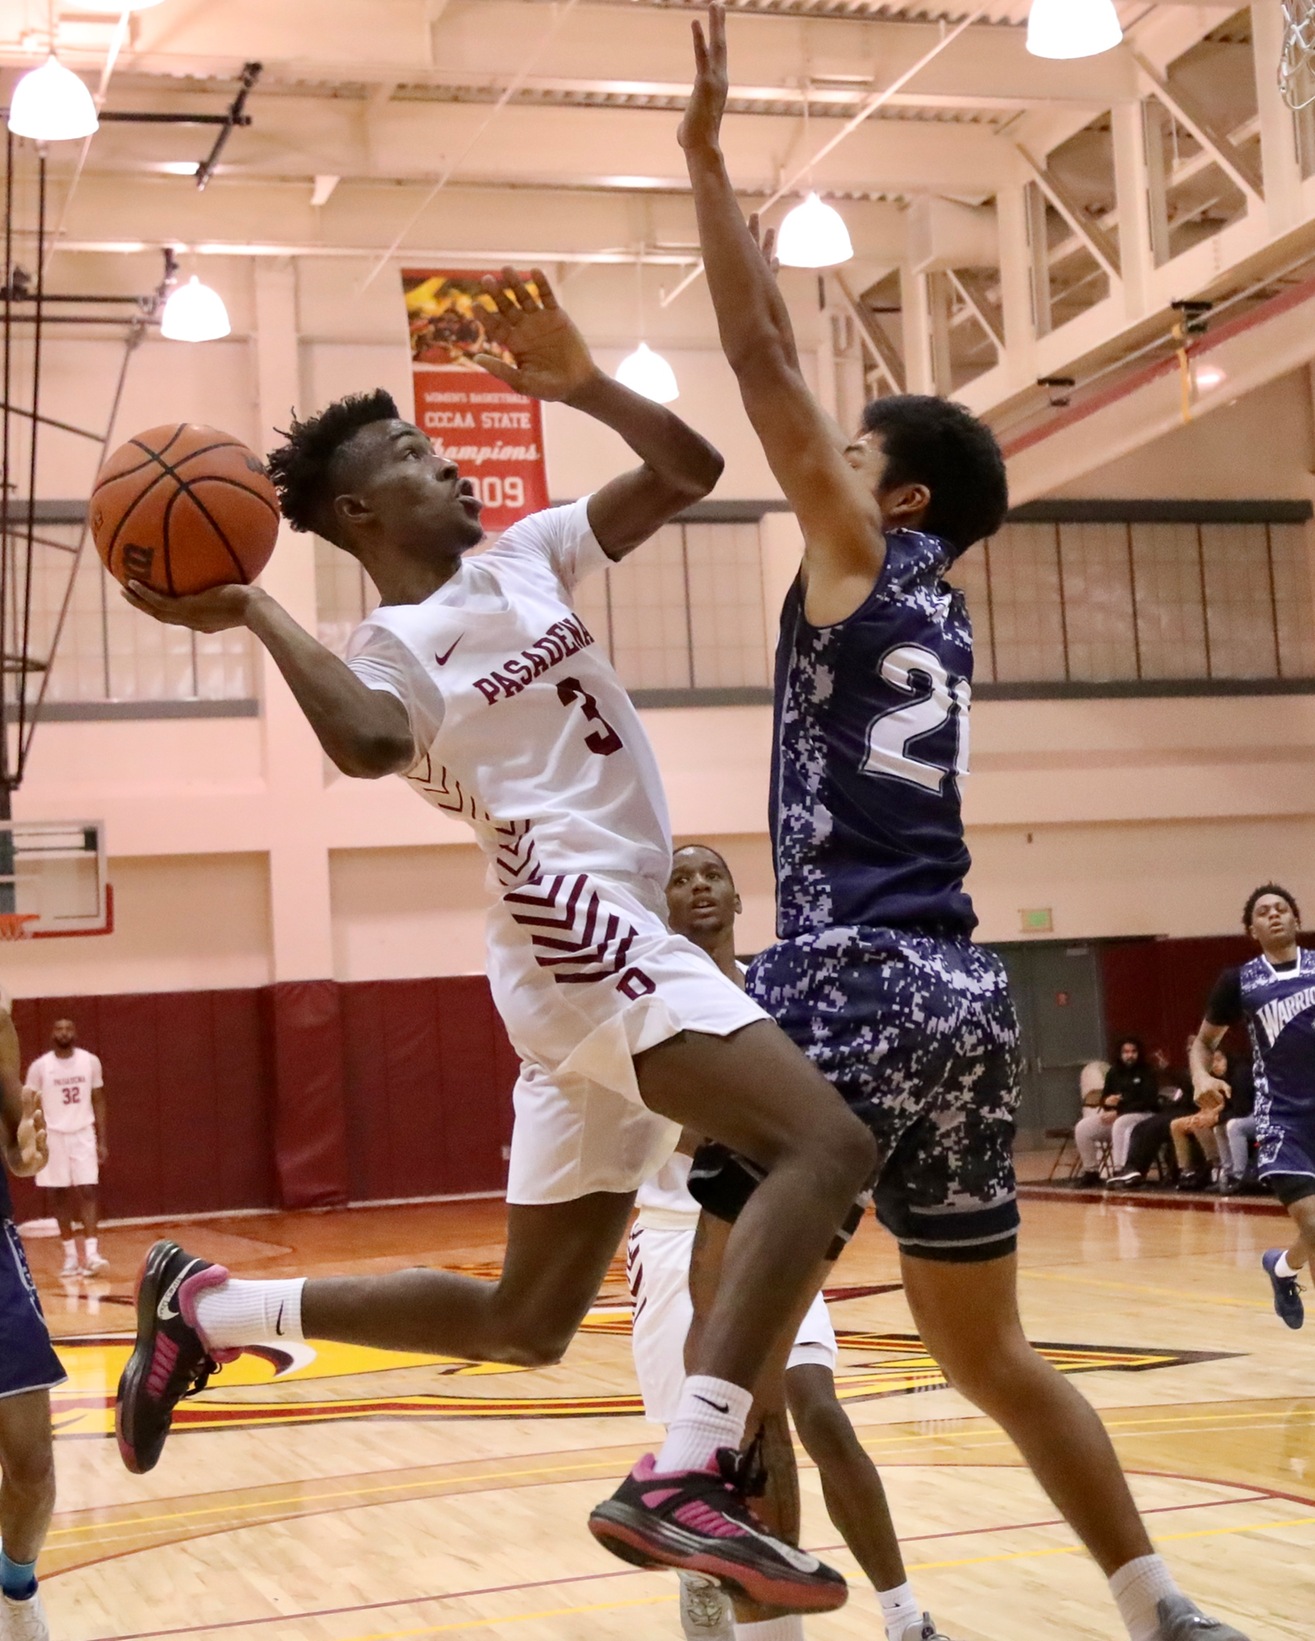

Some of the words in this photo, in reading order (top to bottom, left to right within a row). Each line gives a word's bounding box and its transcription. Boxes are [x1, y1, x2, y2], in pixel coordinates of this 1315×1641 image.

[424, 411, 476, 428] CCCAA
[481, 411, 532, 429] STATE
[430, 437, 540, 466] hampions
[472, 612, 595, 706] PASADENA
[556, 676, 623, 757] 3
[62, 1086, 81, 1105] 32
